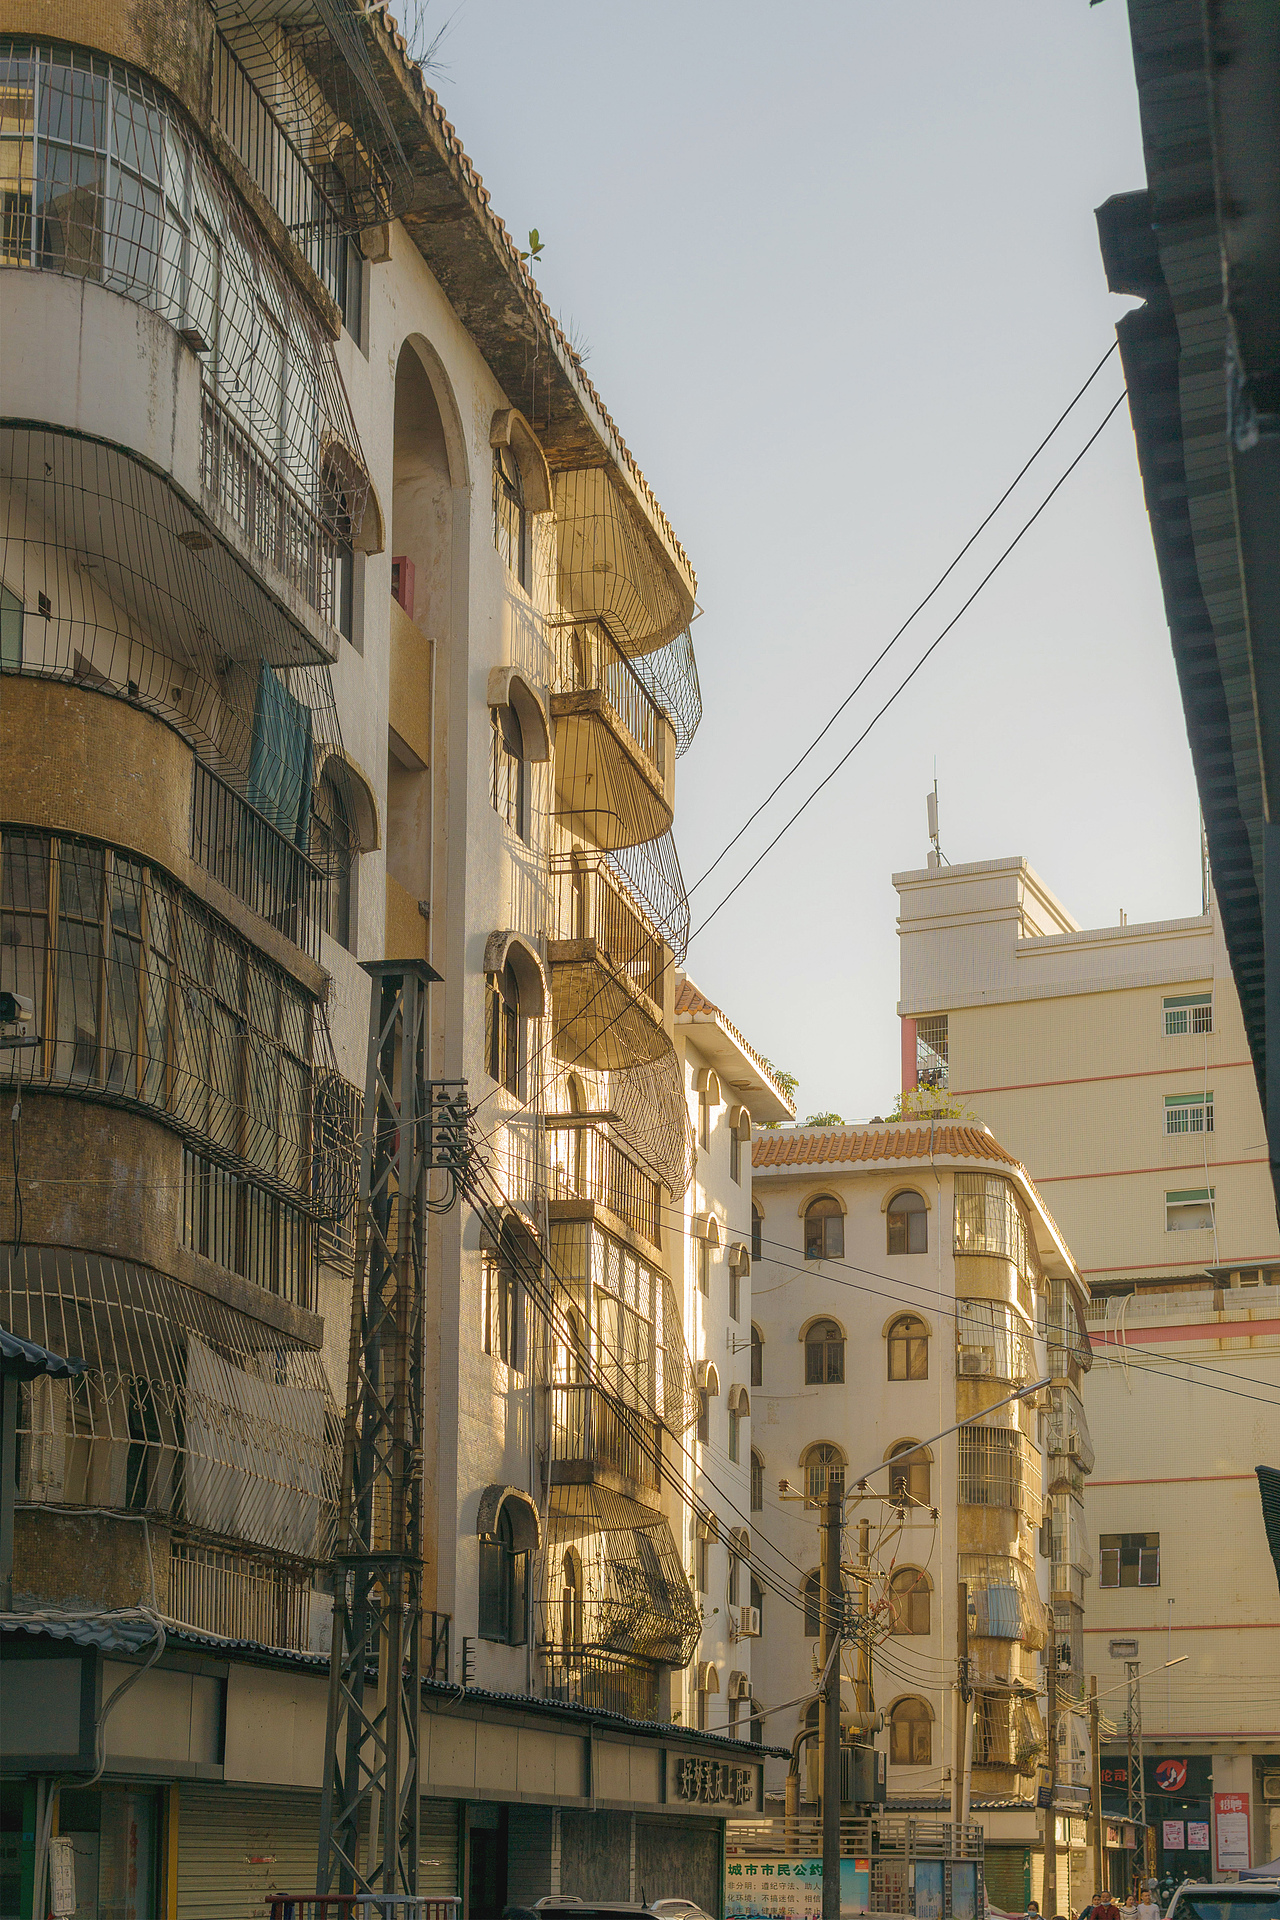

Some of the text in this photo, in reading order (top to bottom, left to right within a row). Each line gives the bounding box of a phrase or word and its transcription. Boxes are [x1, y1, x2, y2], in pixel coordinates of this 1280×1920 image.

[728, 1863, 823, 1877] 城市市民公约
